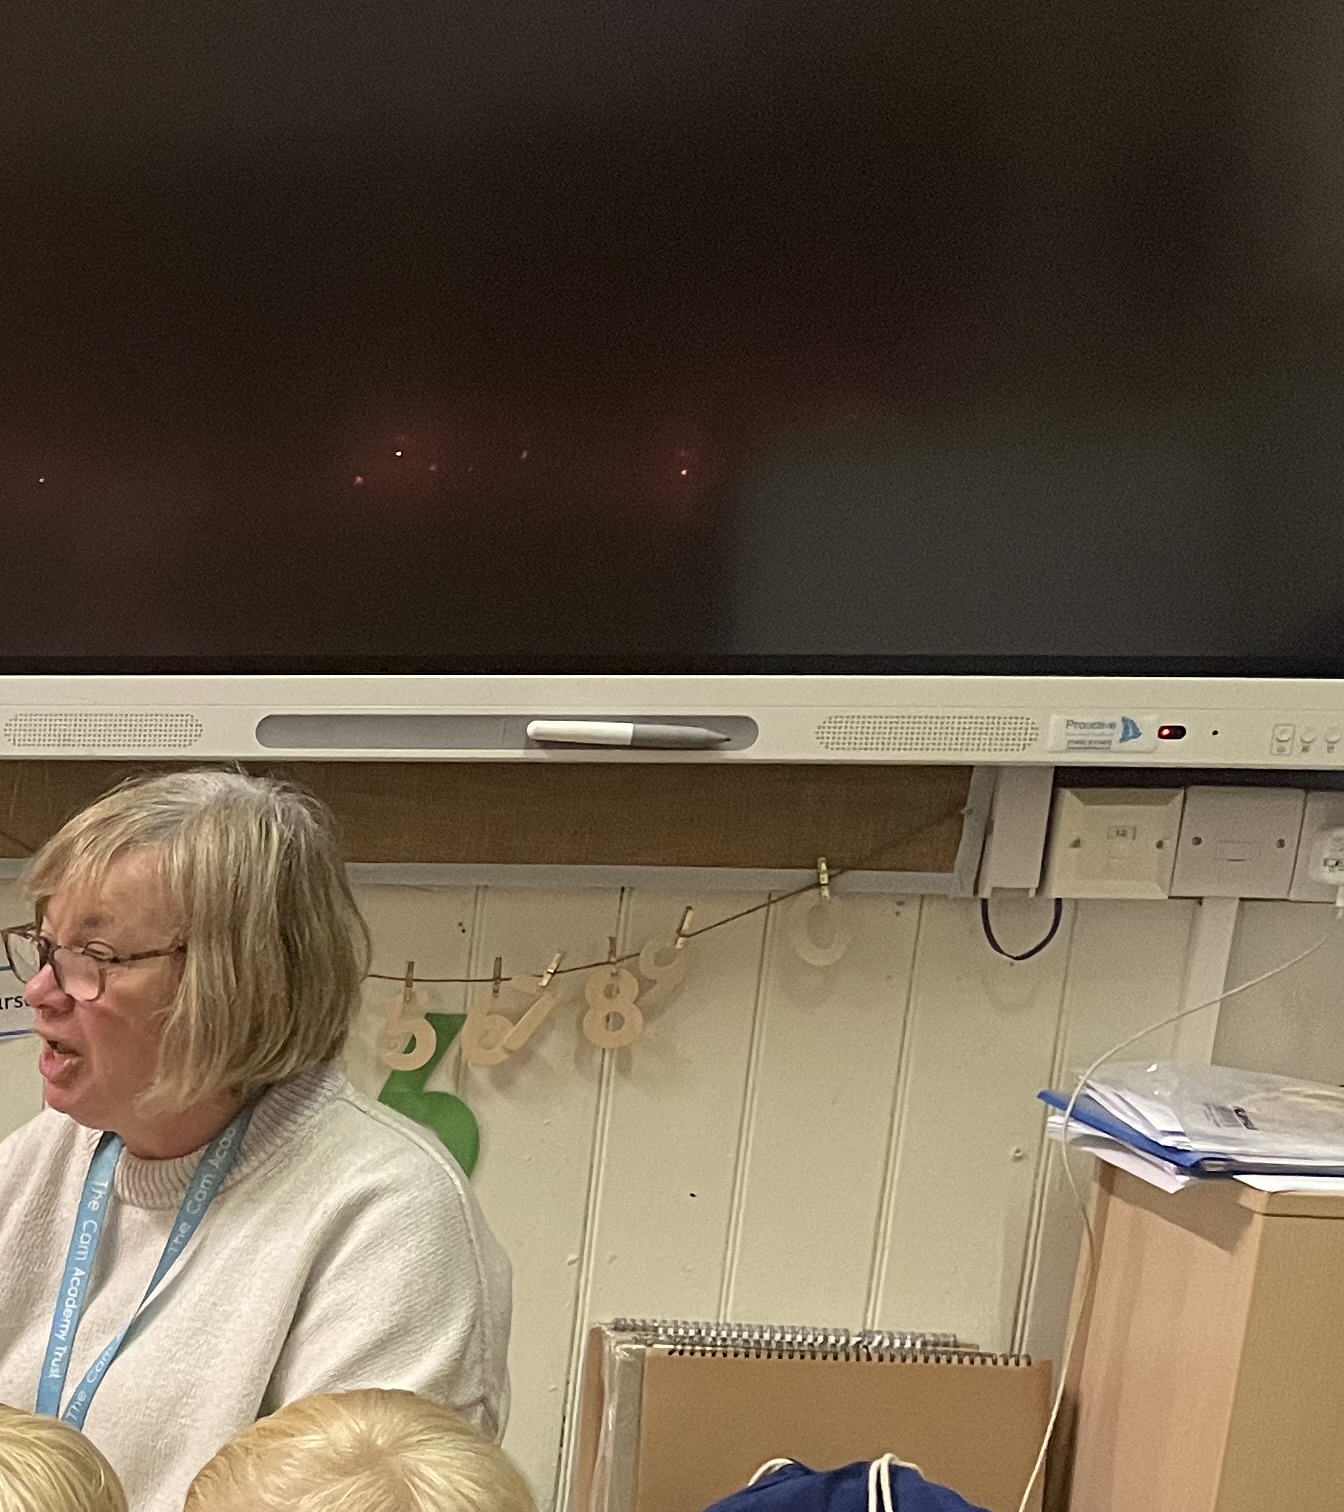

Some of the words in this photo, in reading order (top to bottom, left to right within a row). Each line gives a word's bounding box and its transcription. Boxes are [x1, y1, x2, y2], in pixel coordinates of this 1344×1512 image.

[583, 967, 643, 1049] 8
[87, 1180, 108, 1212] The
[74, 1220, 98, 1261] Cam
[168, 1222, 192, 1254] The
[54, 1267, 86, 1342] Academy
[48, 1345, 68, 1379] Trust
[66, 1390, 87, 1421] The
